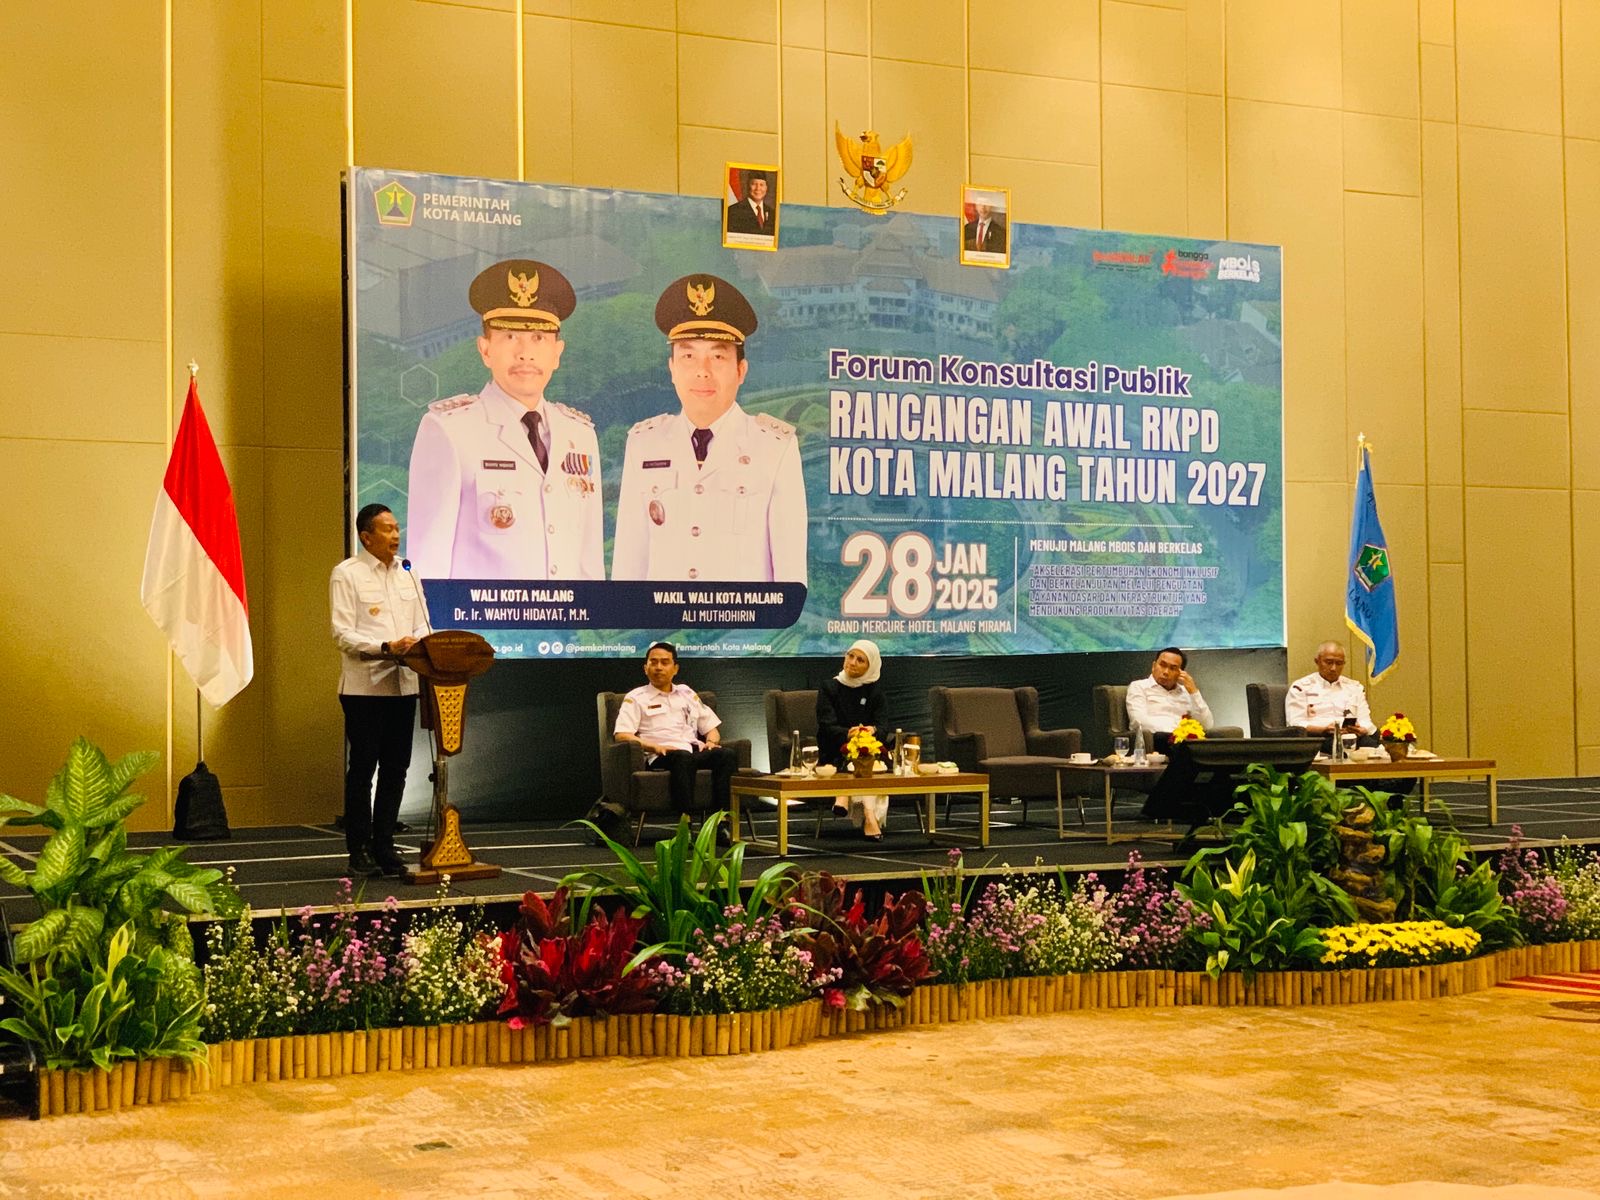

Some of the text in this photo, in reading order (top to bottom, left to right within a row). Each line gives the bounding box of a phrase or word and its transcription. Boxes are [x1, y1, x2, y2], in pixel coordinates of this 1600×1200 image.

[423, 193, 510, 211] PEMERINTAH
[423, 208, 522, 226] KOTA MALANG
[829, 348, 1192, 398] Forum Konsultasi Publik
[829, 390, 1220, 454] RANCANGAN AWAL RKPD
[829, 446, 1267, 507] KOTA MALANG TAHUN 2027
[1029, 539, 1203, 555] MENUJU MALANG MBOIS DAN BERKELAS
[936, 543, 987, 575] JAN
[841, 530, 935, 618] 28
[1086, 565, 1145, 577] PERTUMBUHAN
[1147, 566, 1182, 578] EKONOMI
[1029, 578, 1204, 591] DAN BERKELANJUTAN MELALUI PENGUATAN
[470, 589, 575, 603] WALI KOTA MALANG
[653, 591, 784, 605] WAKIL WALI KOTA MALANG
[1029, 591, 1207, 604] LAYANAN DASAR DAN INFRASTRUKTUR YANG
[454, 608, 590, 622] Dr. Ir. WAHYU HIDAYAT, M.M.
[682, 610, 756, 623] ALI MUTHOHIRIN
[1029, 604, 1080, 616] MENDUKUNG
[1082, 605, 1146, 617] PRODUKTIVITAS
[827, 620, 1012, 634] GRAND MERCURE HOTEL MALANG MIRAMA
[565, 643, 637, 654] @pemkotmalang
[675, 643, 772, 653] Pemerintah Kota Malang
